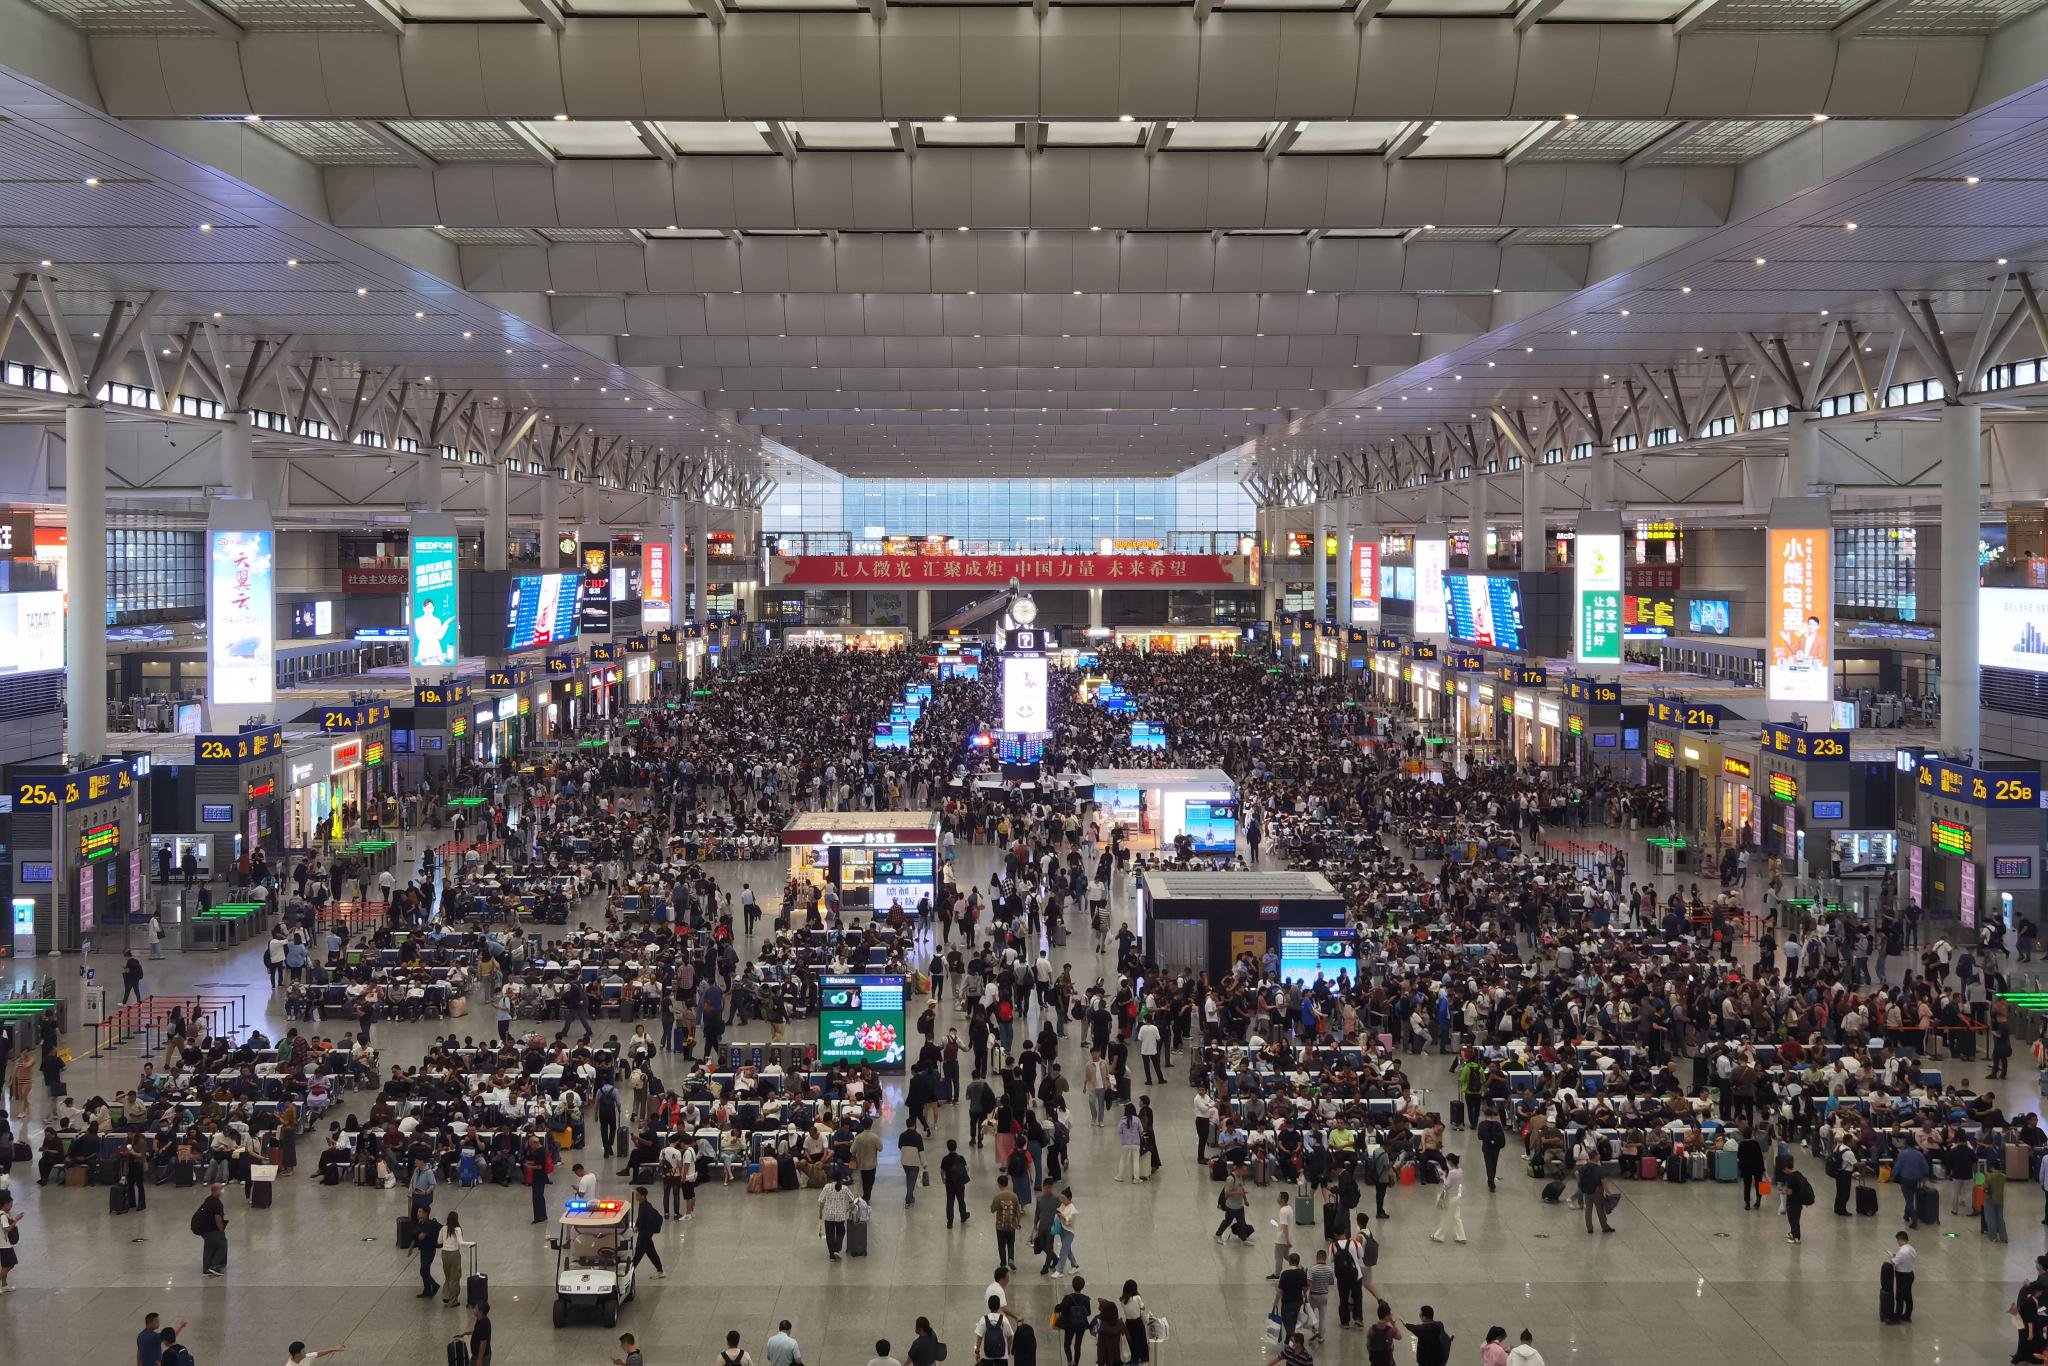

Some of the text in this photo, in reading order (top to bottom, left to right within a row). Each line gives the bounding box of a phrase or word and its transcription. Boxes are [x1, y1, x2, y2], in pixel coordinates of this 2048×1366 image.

[1114, 540, 1160, 548] BURGER KING
[832, 560, 1187, 578] 凡人微光 汇聚成炬 中国力量 未来希望
[232, 552, 251, 609] 天翼云
[349, 575, 407, 584] 社会主义核心
[585, 580, 605, 588] CBD
[1783, 538, 1804, 630] 小熊电器
[1594, 596, 1605, 646] 让家更好
[1606, 596, 1617, 633] 兔宝宝
[594, 649, 609, 658] 13A
[1418, 648, 1433, 657] 13B
[550, 660, 566, 670] 15A
[1463, 658, 1480, 668] 15B
[490, 674, 510, 685] 17A
[1523, 672, 1542, 683] 17B
[420, 691, 441, 703] 19A
[1595, 688, 1616, 700] 19B
[325, 712, 352, 727] 21A
[1688, 710, 1714, 724] 21B
[202, 742, 232, 758] 23A
[1814, 739, 1844, 755] 23B
[119, 771, 131, 790] 24A
[1920, 766, 1933, 786] 24B
[20, 785, 58, 804] 25A
[66, 783, 80, 803] 25A
[1973, 778, 1986, 799] 25B
[1996, 781, 2032, 800] 25B
